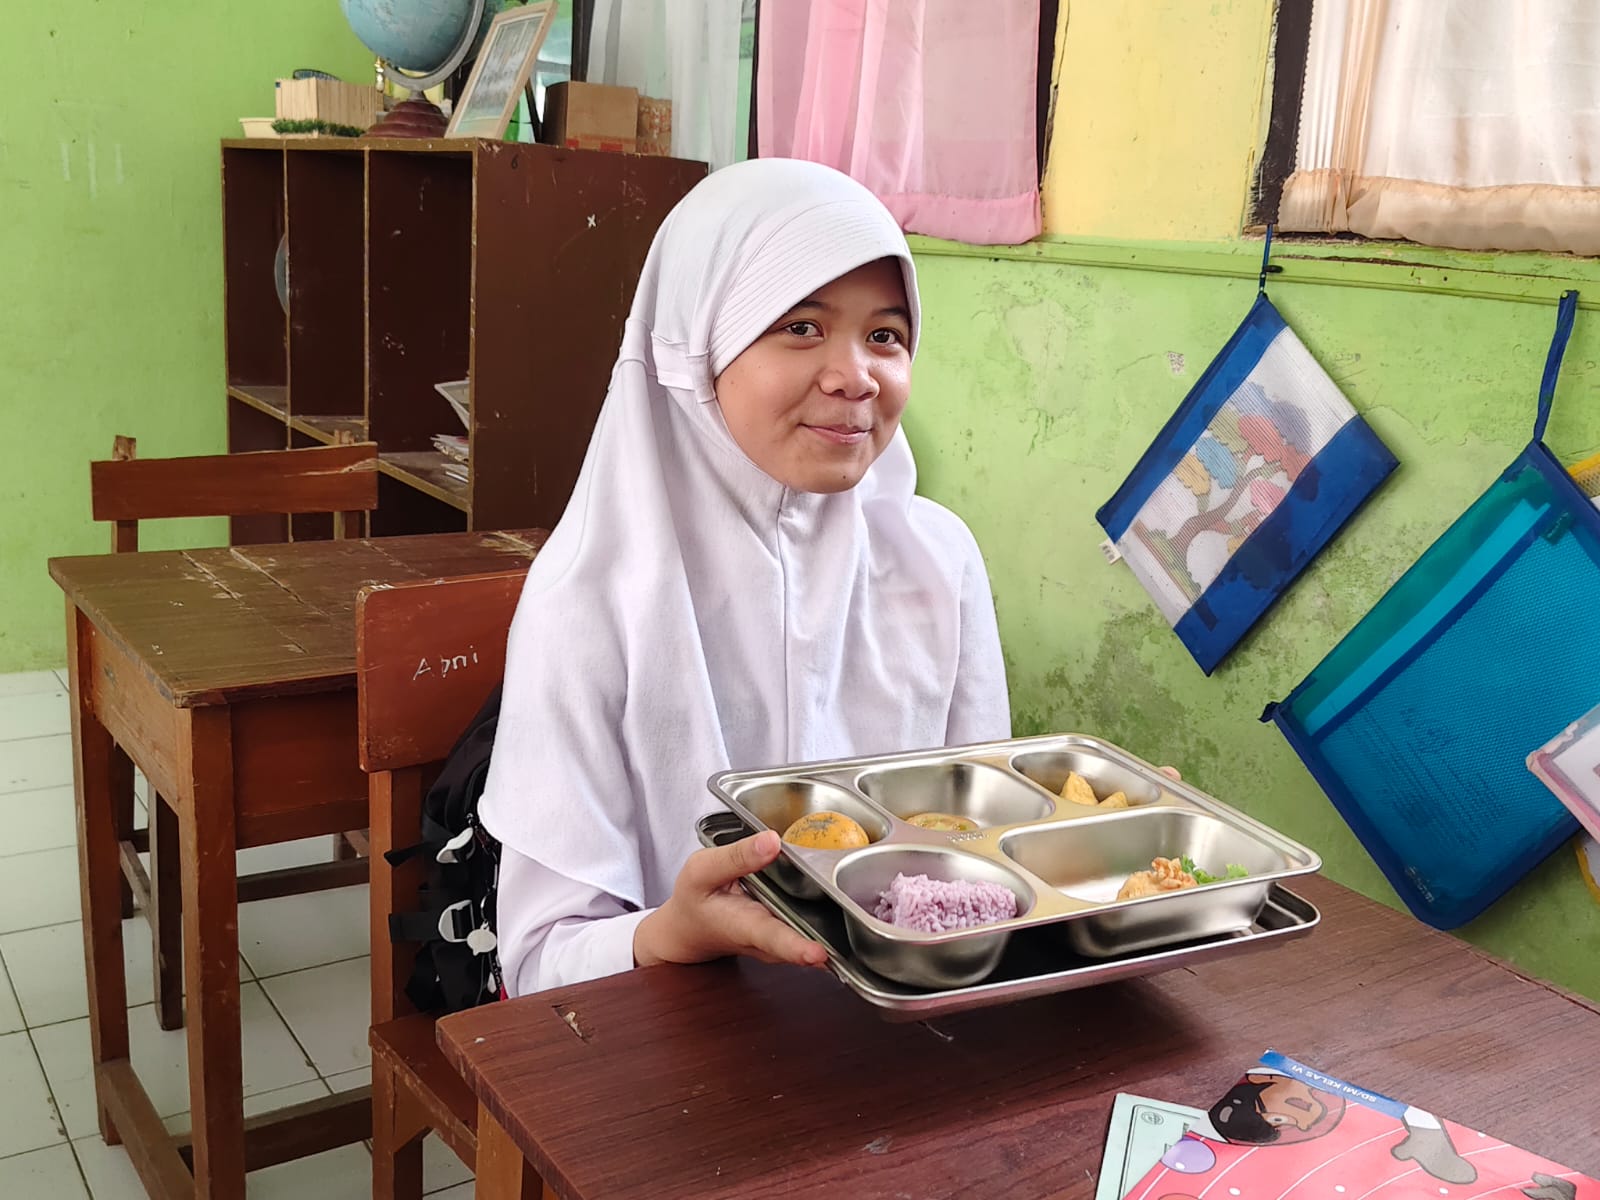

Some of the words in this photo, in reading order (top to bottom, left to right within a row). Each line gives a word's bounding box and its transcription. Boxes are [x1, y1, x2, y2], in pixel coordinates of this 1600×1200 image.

[1291, 1065, 1303, 1074] VI
[1305, 1071, 1341, 1089] KELAS
[1343, 1086, 1377, 1103] SD/MI
